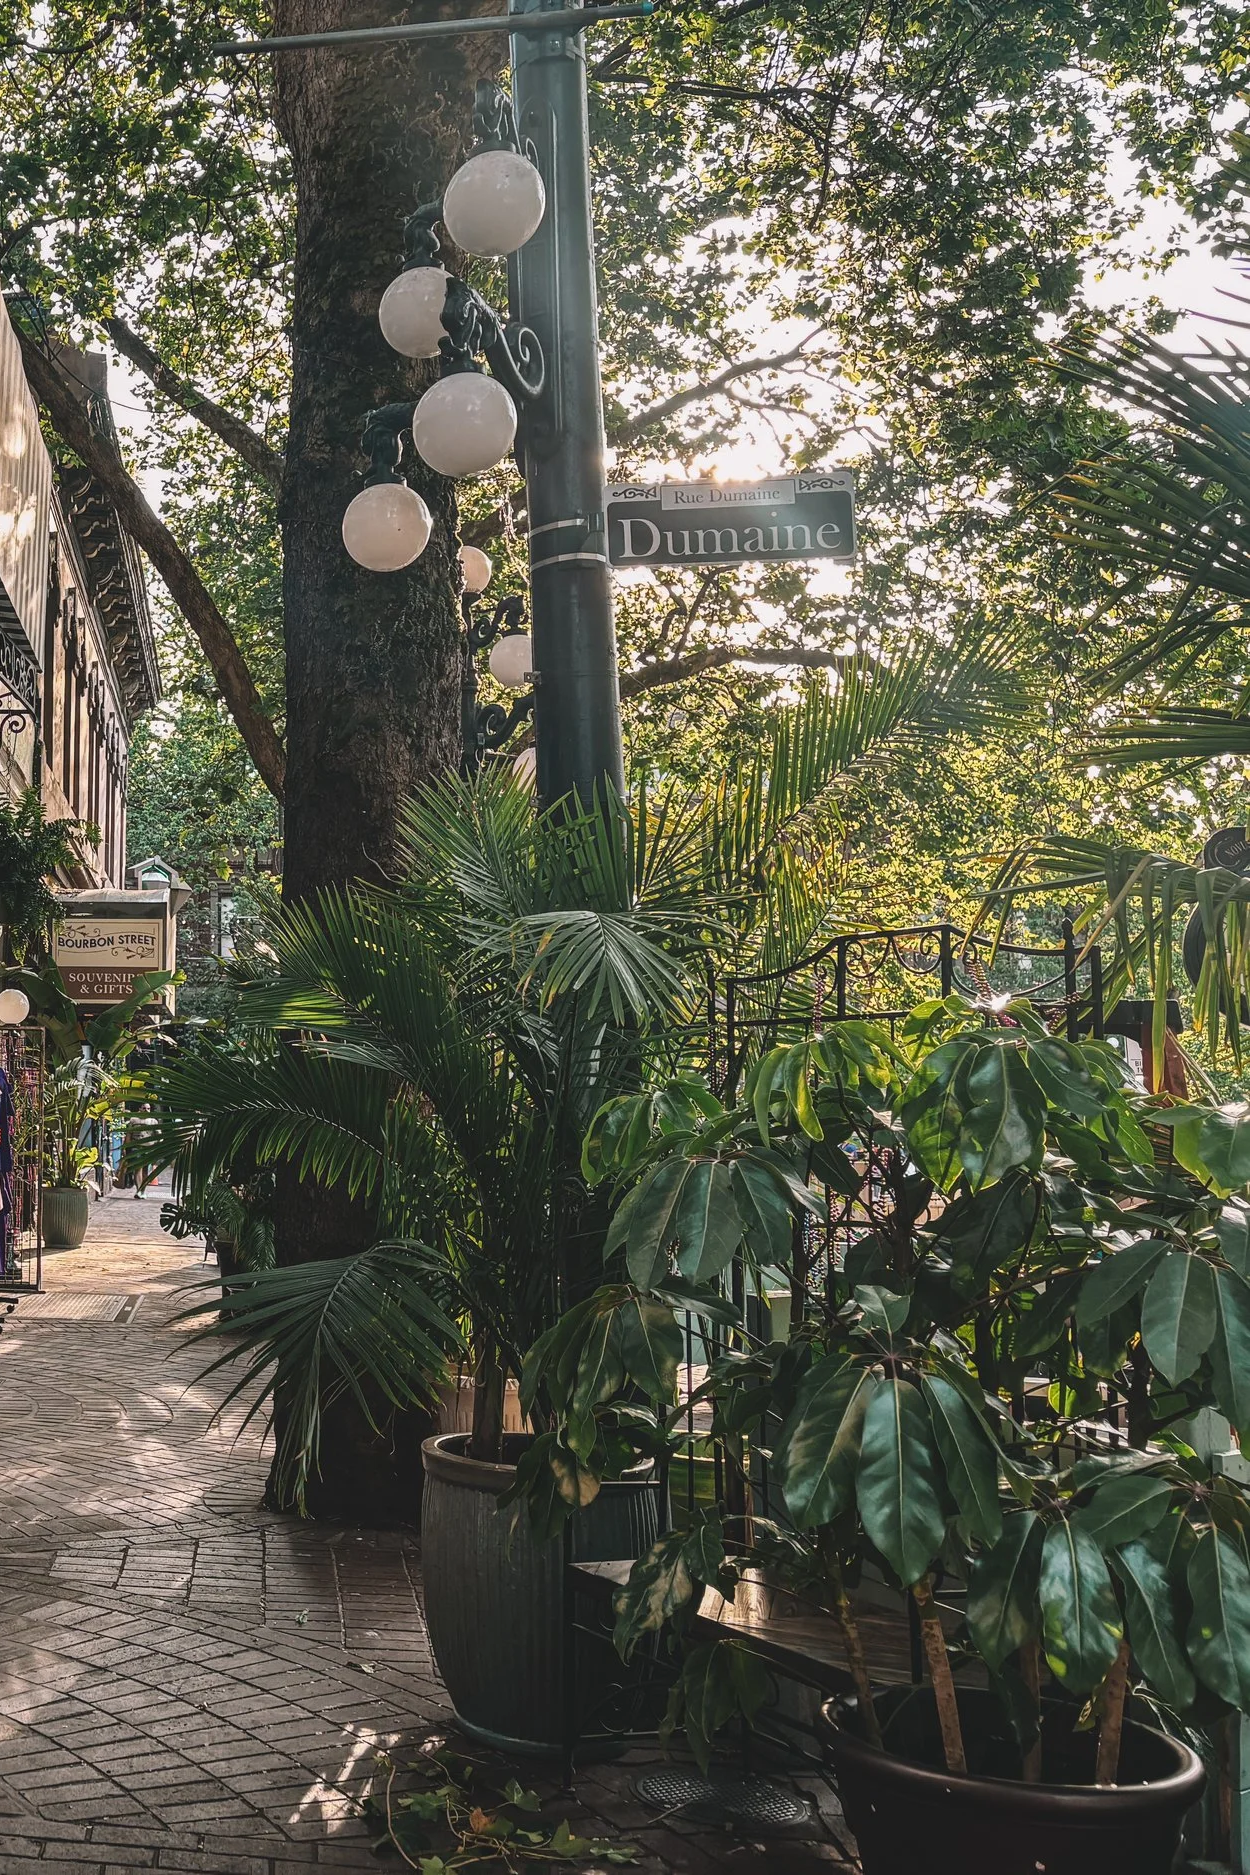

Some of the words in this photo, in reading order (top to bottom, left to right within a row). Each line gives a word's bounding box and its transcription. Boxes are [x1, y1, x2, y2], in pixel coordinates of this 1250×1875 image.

[674, 490, 704, 504] Rue
[710, 487, 780, 503] Dumaine
[618, 511, 841, 559] Dumaine
[58, 936, 114, 949] BOURBON
[118, 934, 156, 947] STREET
[80, 985, 89, 994] &
[94, 984, 133, 994] GIFTS
